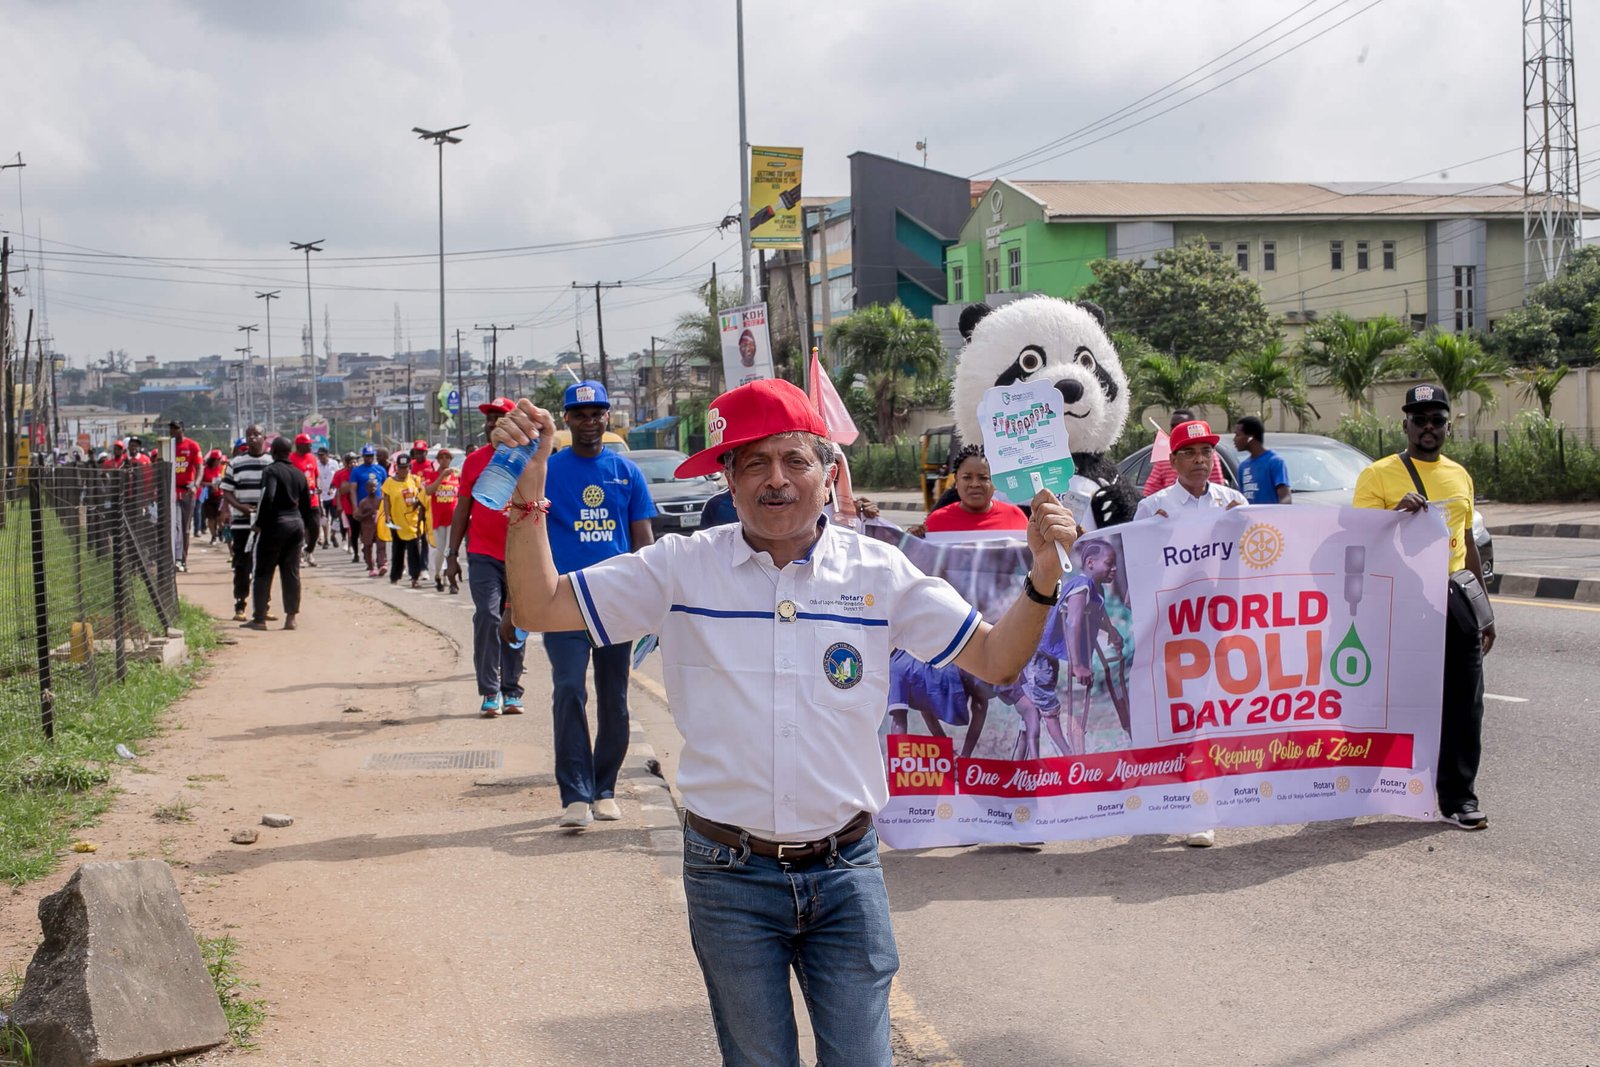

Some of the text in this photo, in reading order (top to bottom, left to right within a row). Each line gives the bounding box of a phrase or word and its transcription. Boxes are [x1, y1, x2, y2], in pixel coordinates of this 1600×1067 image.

[708, 420, 723, 433] LIO
[580, 508, 609, 520] END
[574, 520, 616, 531] POLIO
[580, 531, 613, 542] NOW
[1163, 542, 1233, 566] Rotary
[1168, 590, 1328, 635] WORLD
[1170, 689, 1343, 734] DAY 2026
[898, 742, 940, 758] END
[890, 757, 951, 773] POLIO
[965, 764, 1000, 786] One
[1002, 768, 1062, 792] Mission,
[1068, 762, 1103, 785] One
[1107, 752, 1187, 782] Movement
[1209, 744, 1266, 771] Keeping
[1269, 738, 1302, 762] Polio
[1306, 738, 1324, 758] at
[1326, 737, 1372, 761] Zero!
[896, 772, 944, 787] NOW
[1380, 779, 1407, 789] Rotary
[1234, 788, 1258, 796] Rotary
[909, 807, 936, 816] Rotary
[1097, 802, 1124, 812] Rotary
[988, 809, 1013, 819] Rotary
